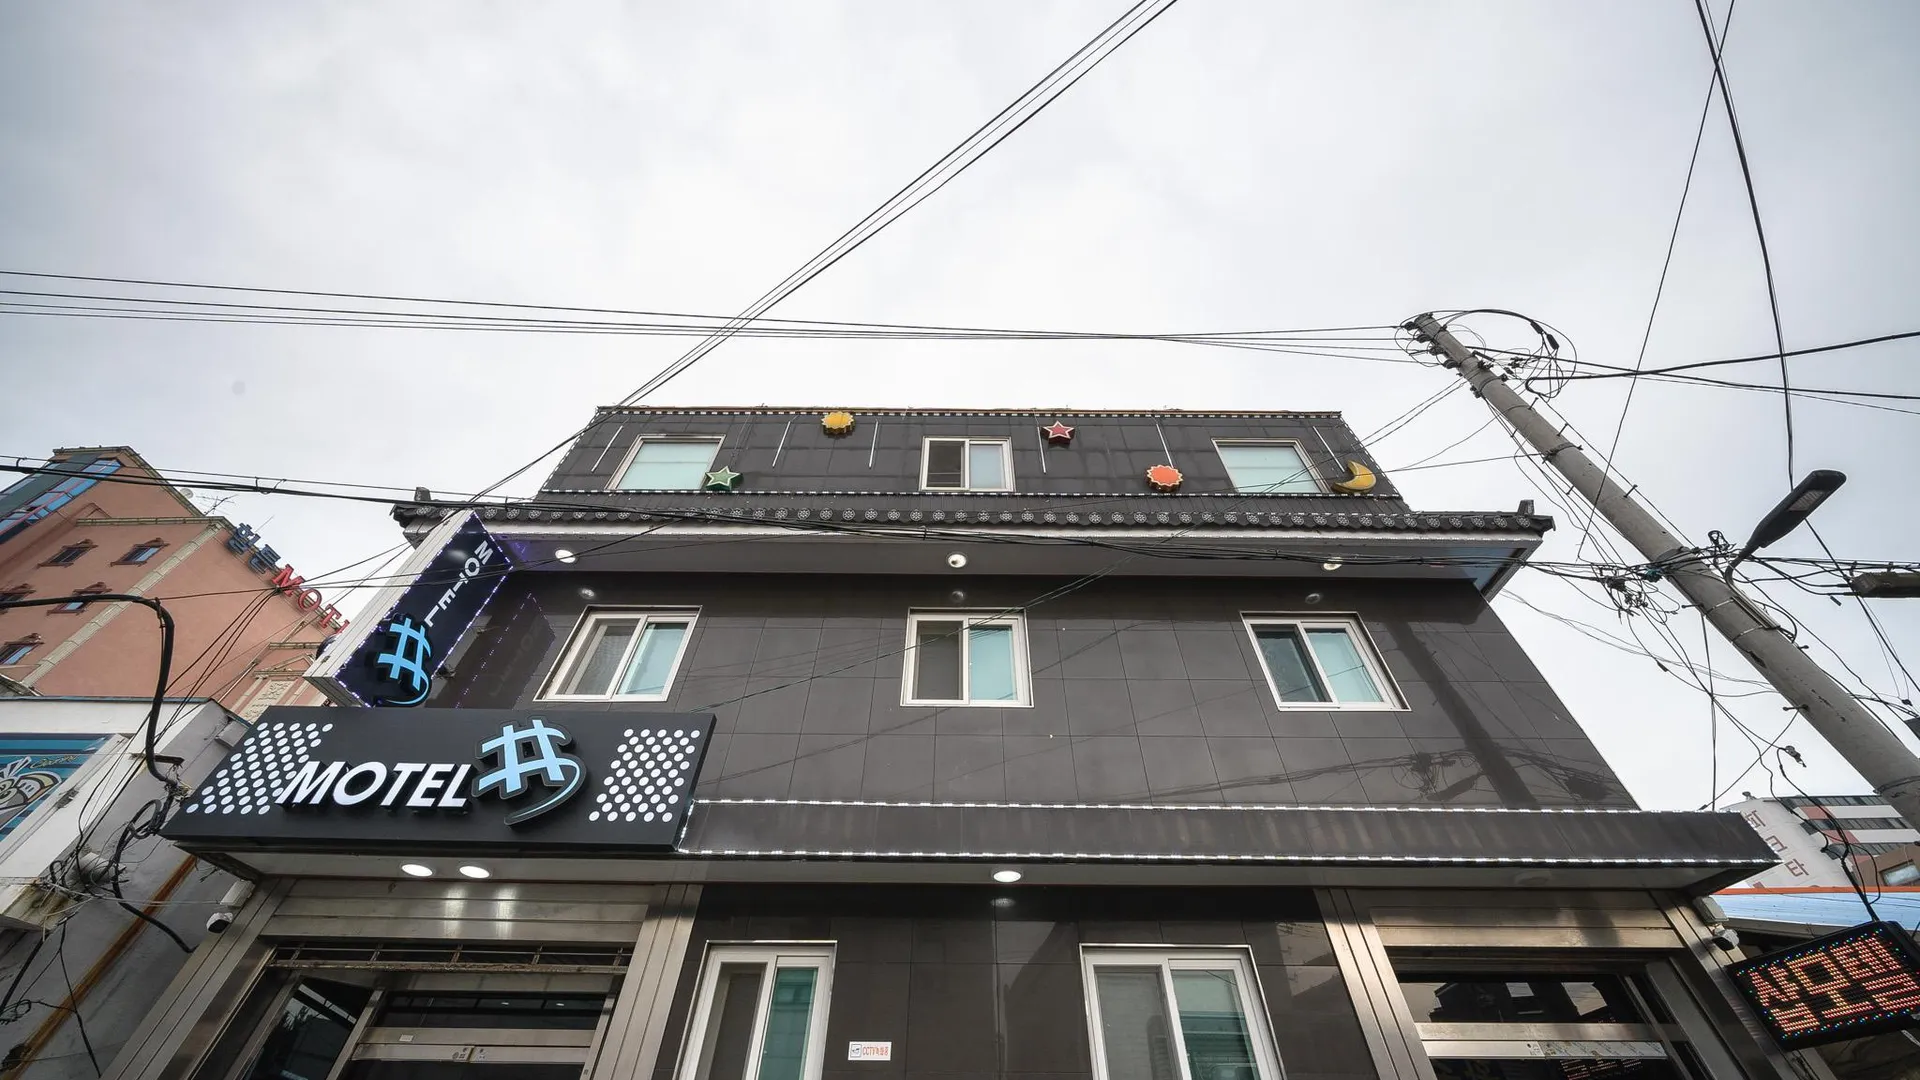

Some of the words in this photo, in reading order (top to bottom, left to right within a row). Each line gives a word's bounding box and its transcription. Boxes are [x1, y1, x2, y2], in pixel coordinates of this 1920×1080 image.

[424, 540, 494, 628] MOTEL
[275, 760, 471, 808] MOTEL
[1750, 937, 1920, 1033] 샵모텔
